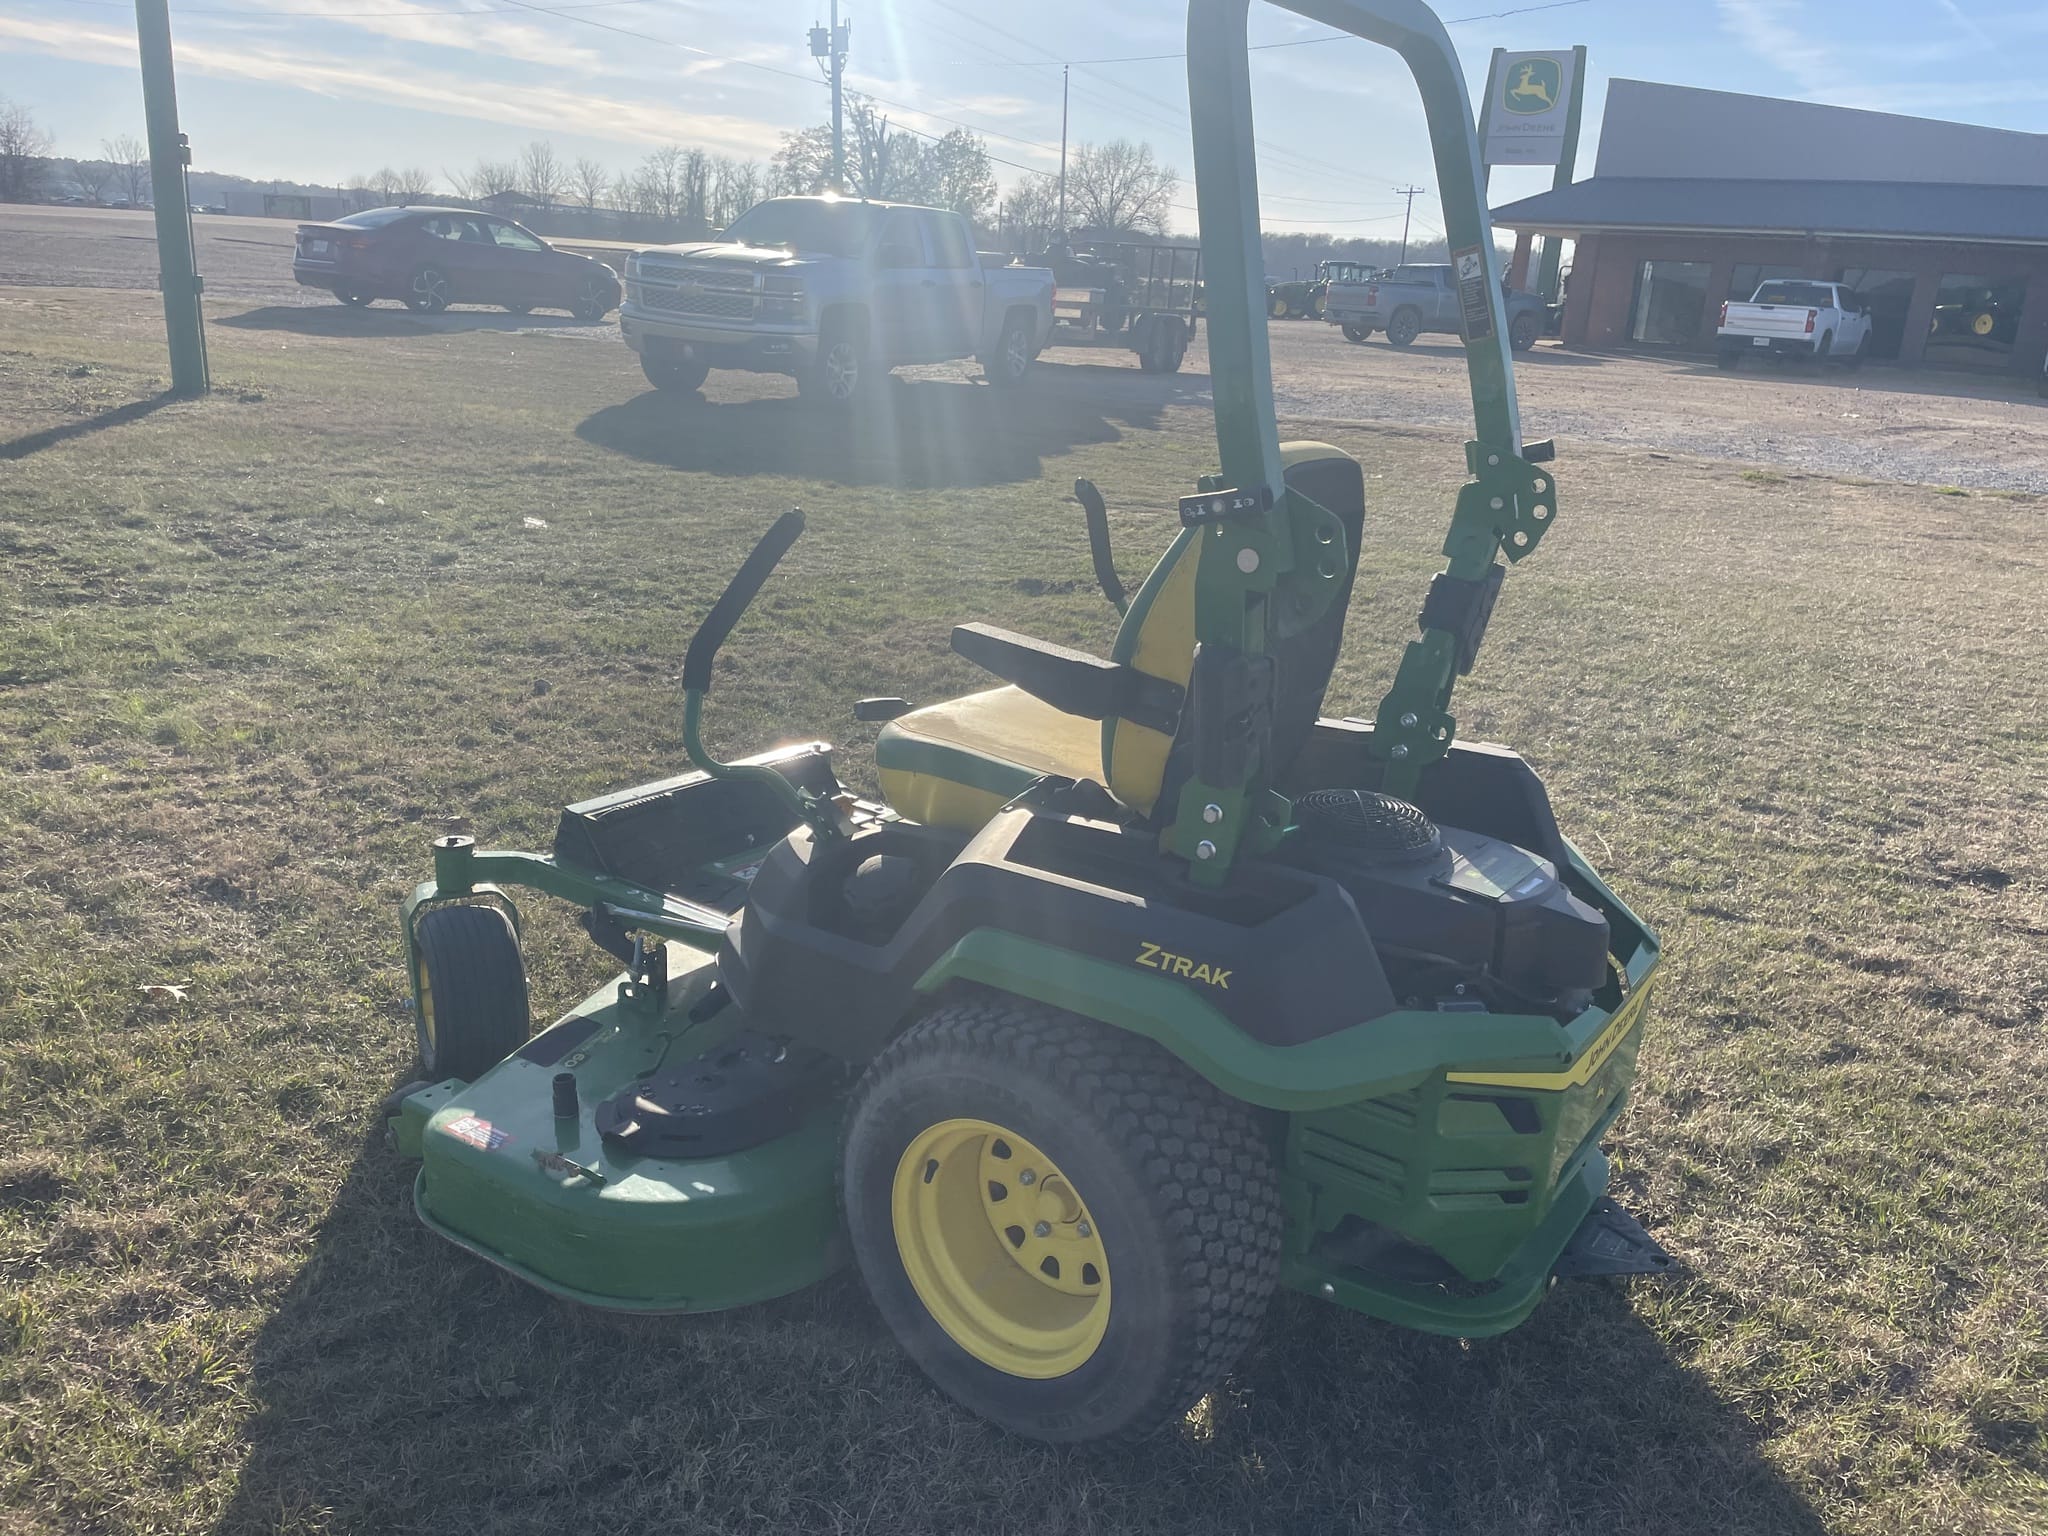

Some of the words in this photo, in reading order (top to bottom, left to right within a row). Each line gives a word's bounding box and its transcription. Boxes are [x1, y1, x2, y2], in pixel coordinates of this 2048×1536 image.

[1135, 941, 1233, 990] ZTRAK
[1585, 1033, 1612, 1074] JOHN
[1611, 999, 1640, 1043] DEERE
